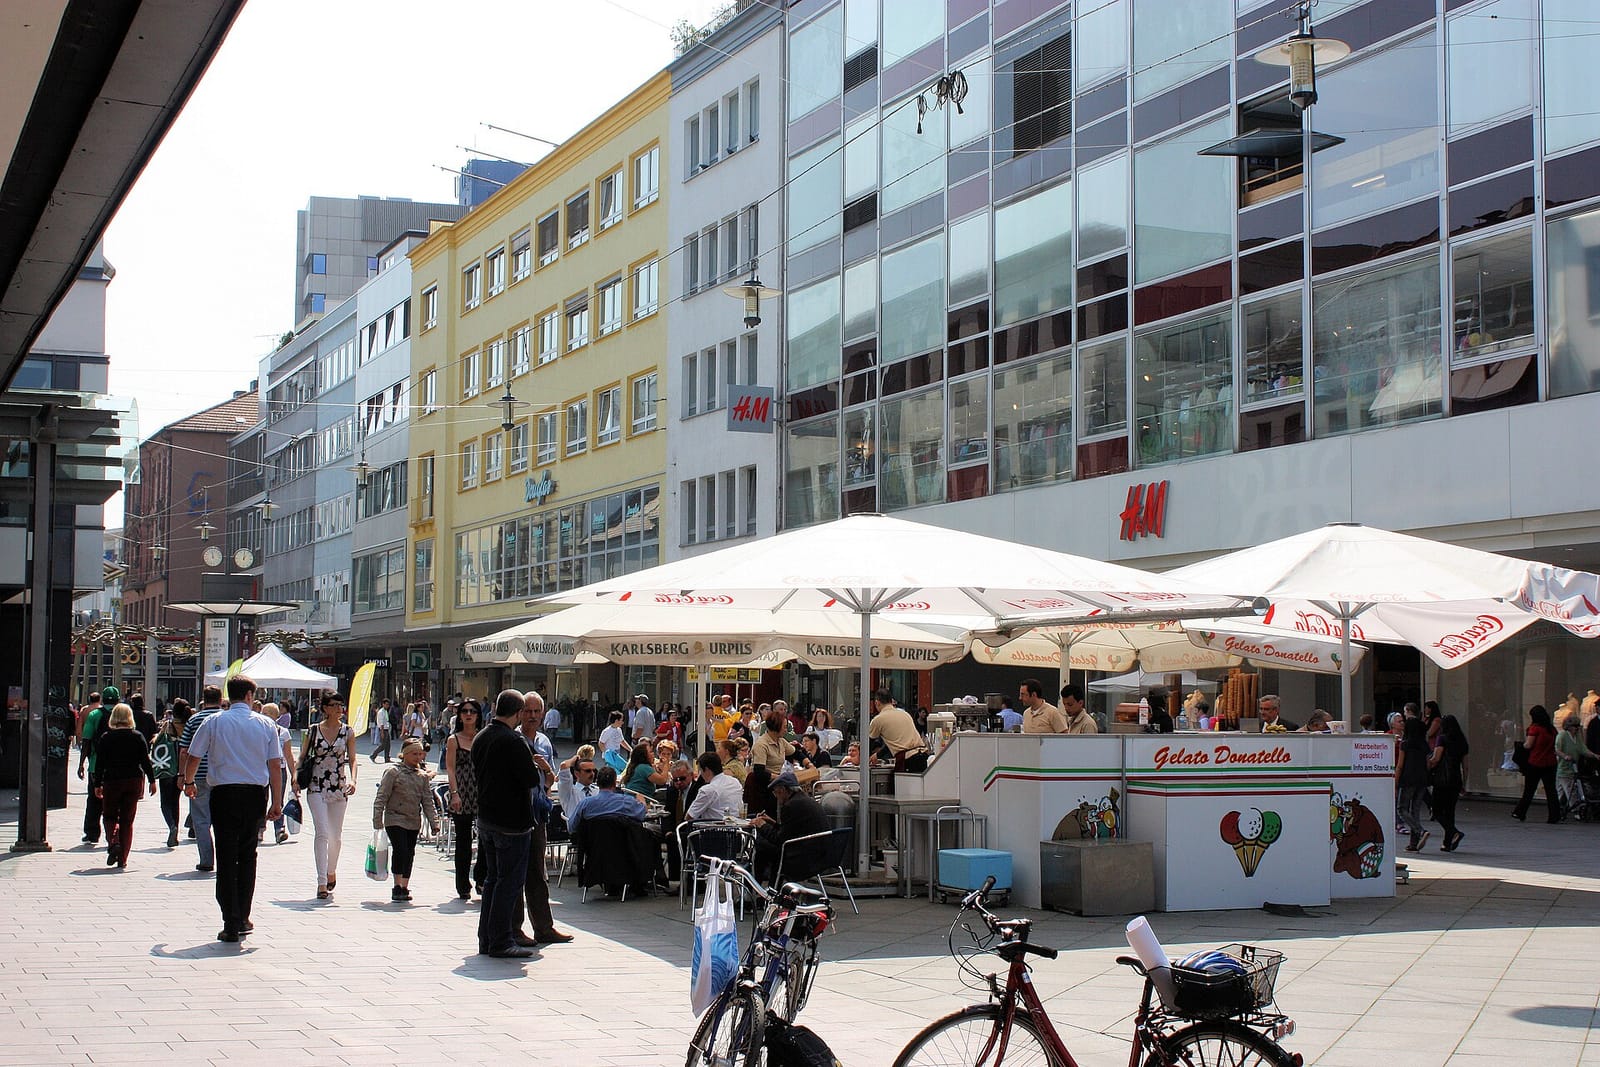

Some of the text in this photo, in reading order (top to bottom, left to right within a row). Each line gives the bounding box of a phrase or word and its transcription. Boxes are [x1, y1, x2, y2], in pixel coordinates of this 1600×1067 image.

[732, 395, 770, 423] H&M
[1119, 480, 1169, 541] H&M
[610, 642, 753, 656] KARLSBERG URPILS
[806, 643, 939, 661] KARLSBEG URPILS
[1224, 636, 1319, 664] Gelato Donatello
[1153, 745, 1291, 770] Gelato Donatello
